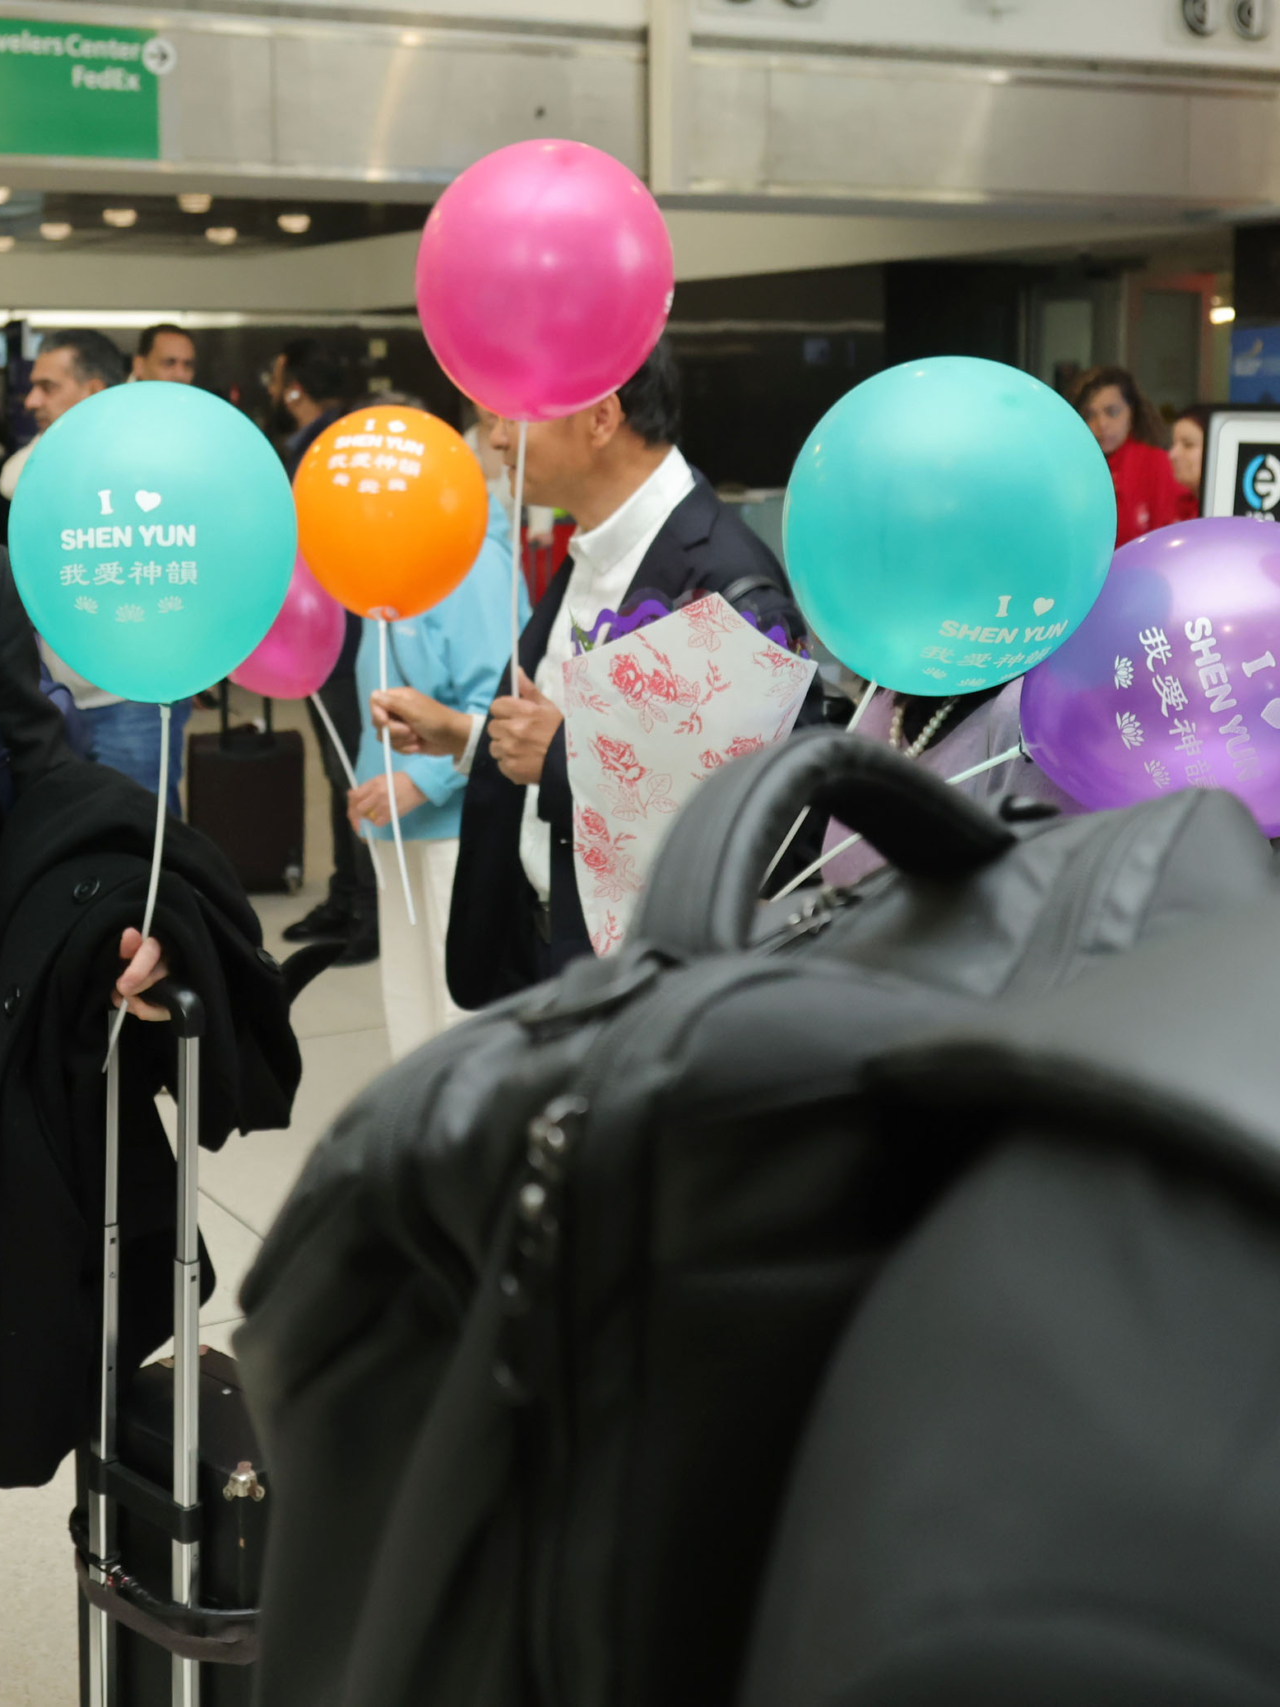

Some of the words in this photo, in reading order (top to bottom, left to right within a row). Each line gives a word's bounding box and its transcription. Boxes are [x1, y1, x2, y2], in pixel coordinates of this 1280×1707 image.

[66, 33, 140, 61] Center
[72, 64, 141, 92] FedEx
[98, 489, 114, 515] I
[60, 525, 133, 551] SHEN
[138, 524, 196, 547] YUN
[59, 560, 198, 586] 我愛神韻
[995, 595, 1012, 618] I
[938, 620, 1019, 644] SHEN
[1023, 619, 1069, 643] YUN
[1241, 650, 1276, 678] I
[1184, 616, 1238, 713] SHEN
[1219, 714, 1265, 782] YUN
